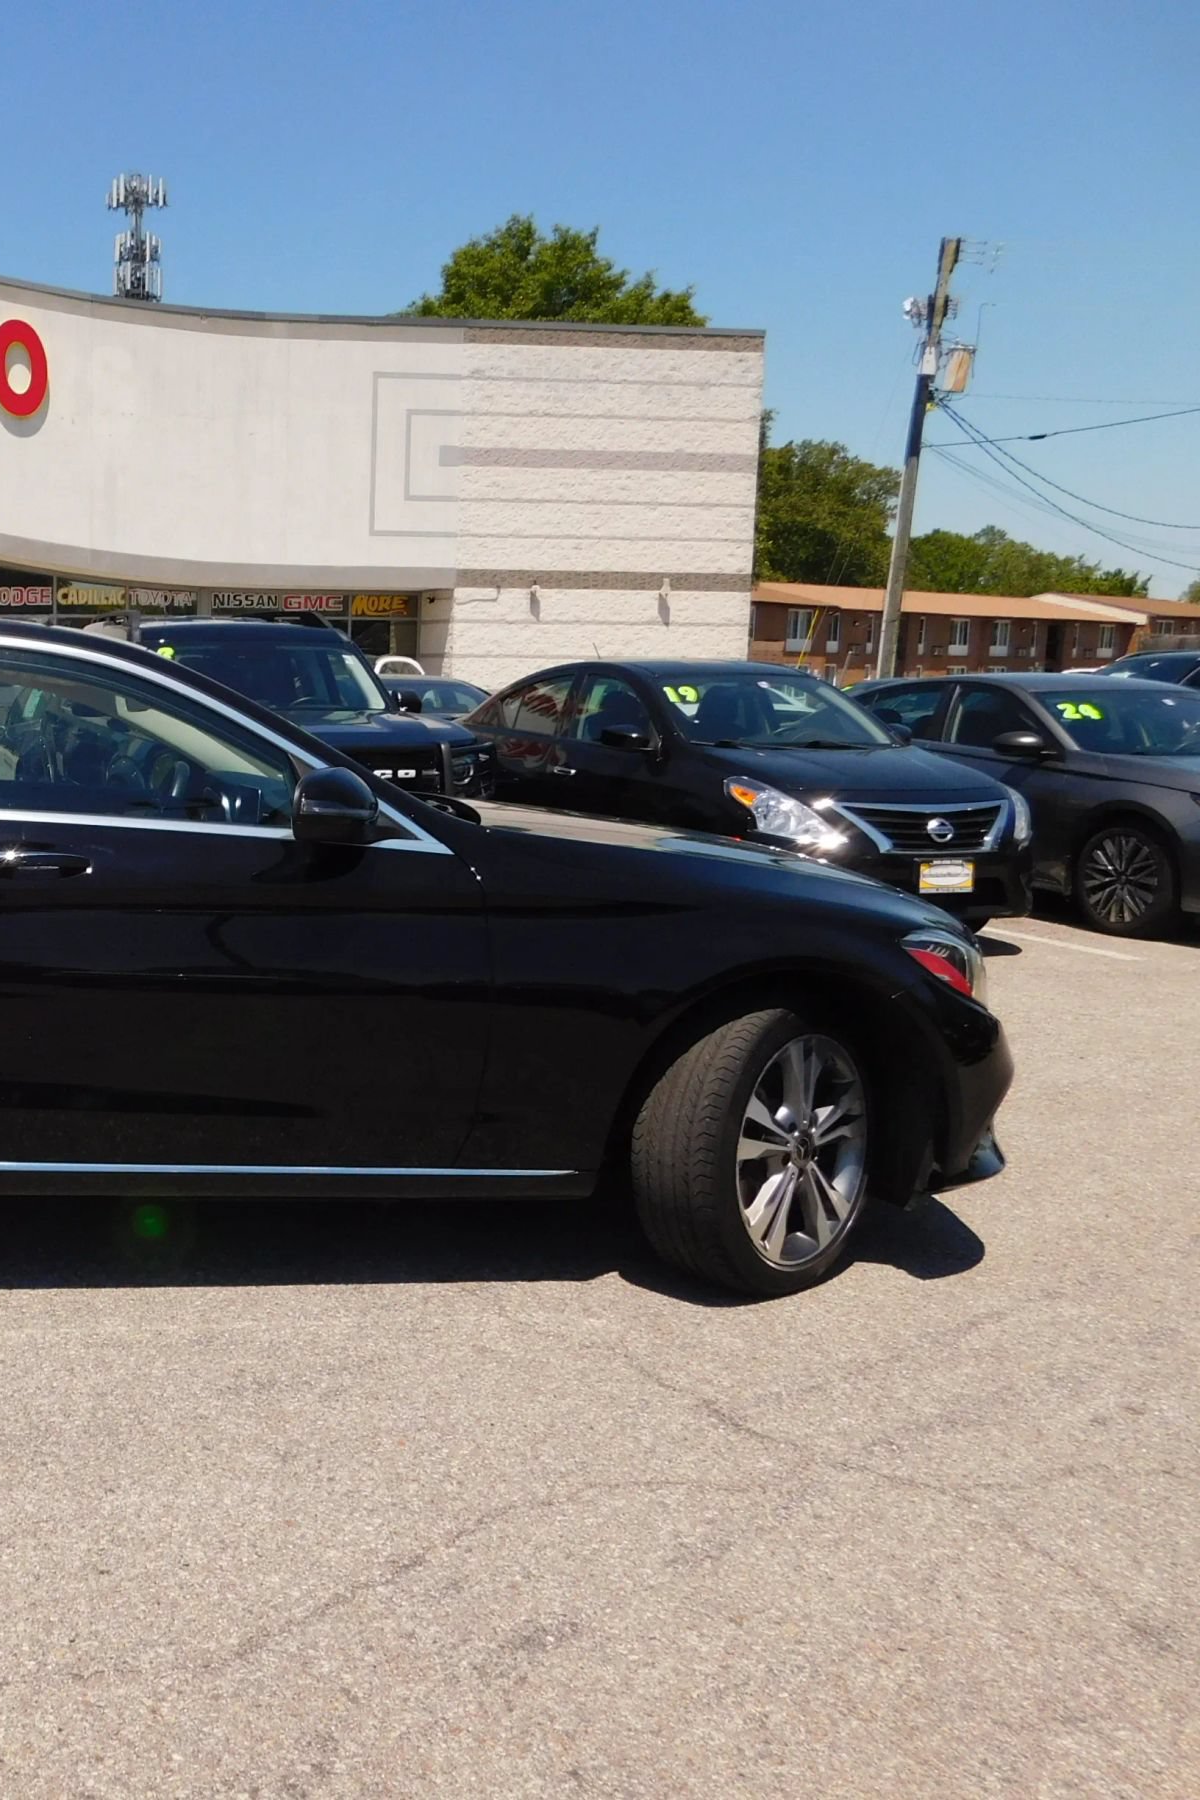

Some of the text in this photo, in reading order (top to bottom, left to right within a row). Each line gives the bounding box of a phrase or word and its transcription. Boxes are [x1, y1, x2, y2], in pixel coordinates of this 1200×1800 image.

[56, 588, 126, 606] CADILLAC
[128, 588, 193, 608] TOYOTA
[212, 592, 279, 609] NISSAN
[282, 594, 343, 612] GMC
[351, 594, 410, 616] MORE
[662, 686, 698, 703] 19
